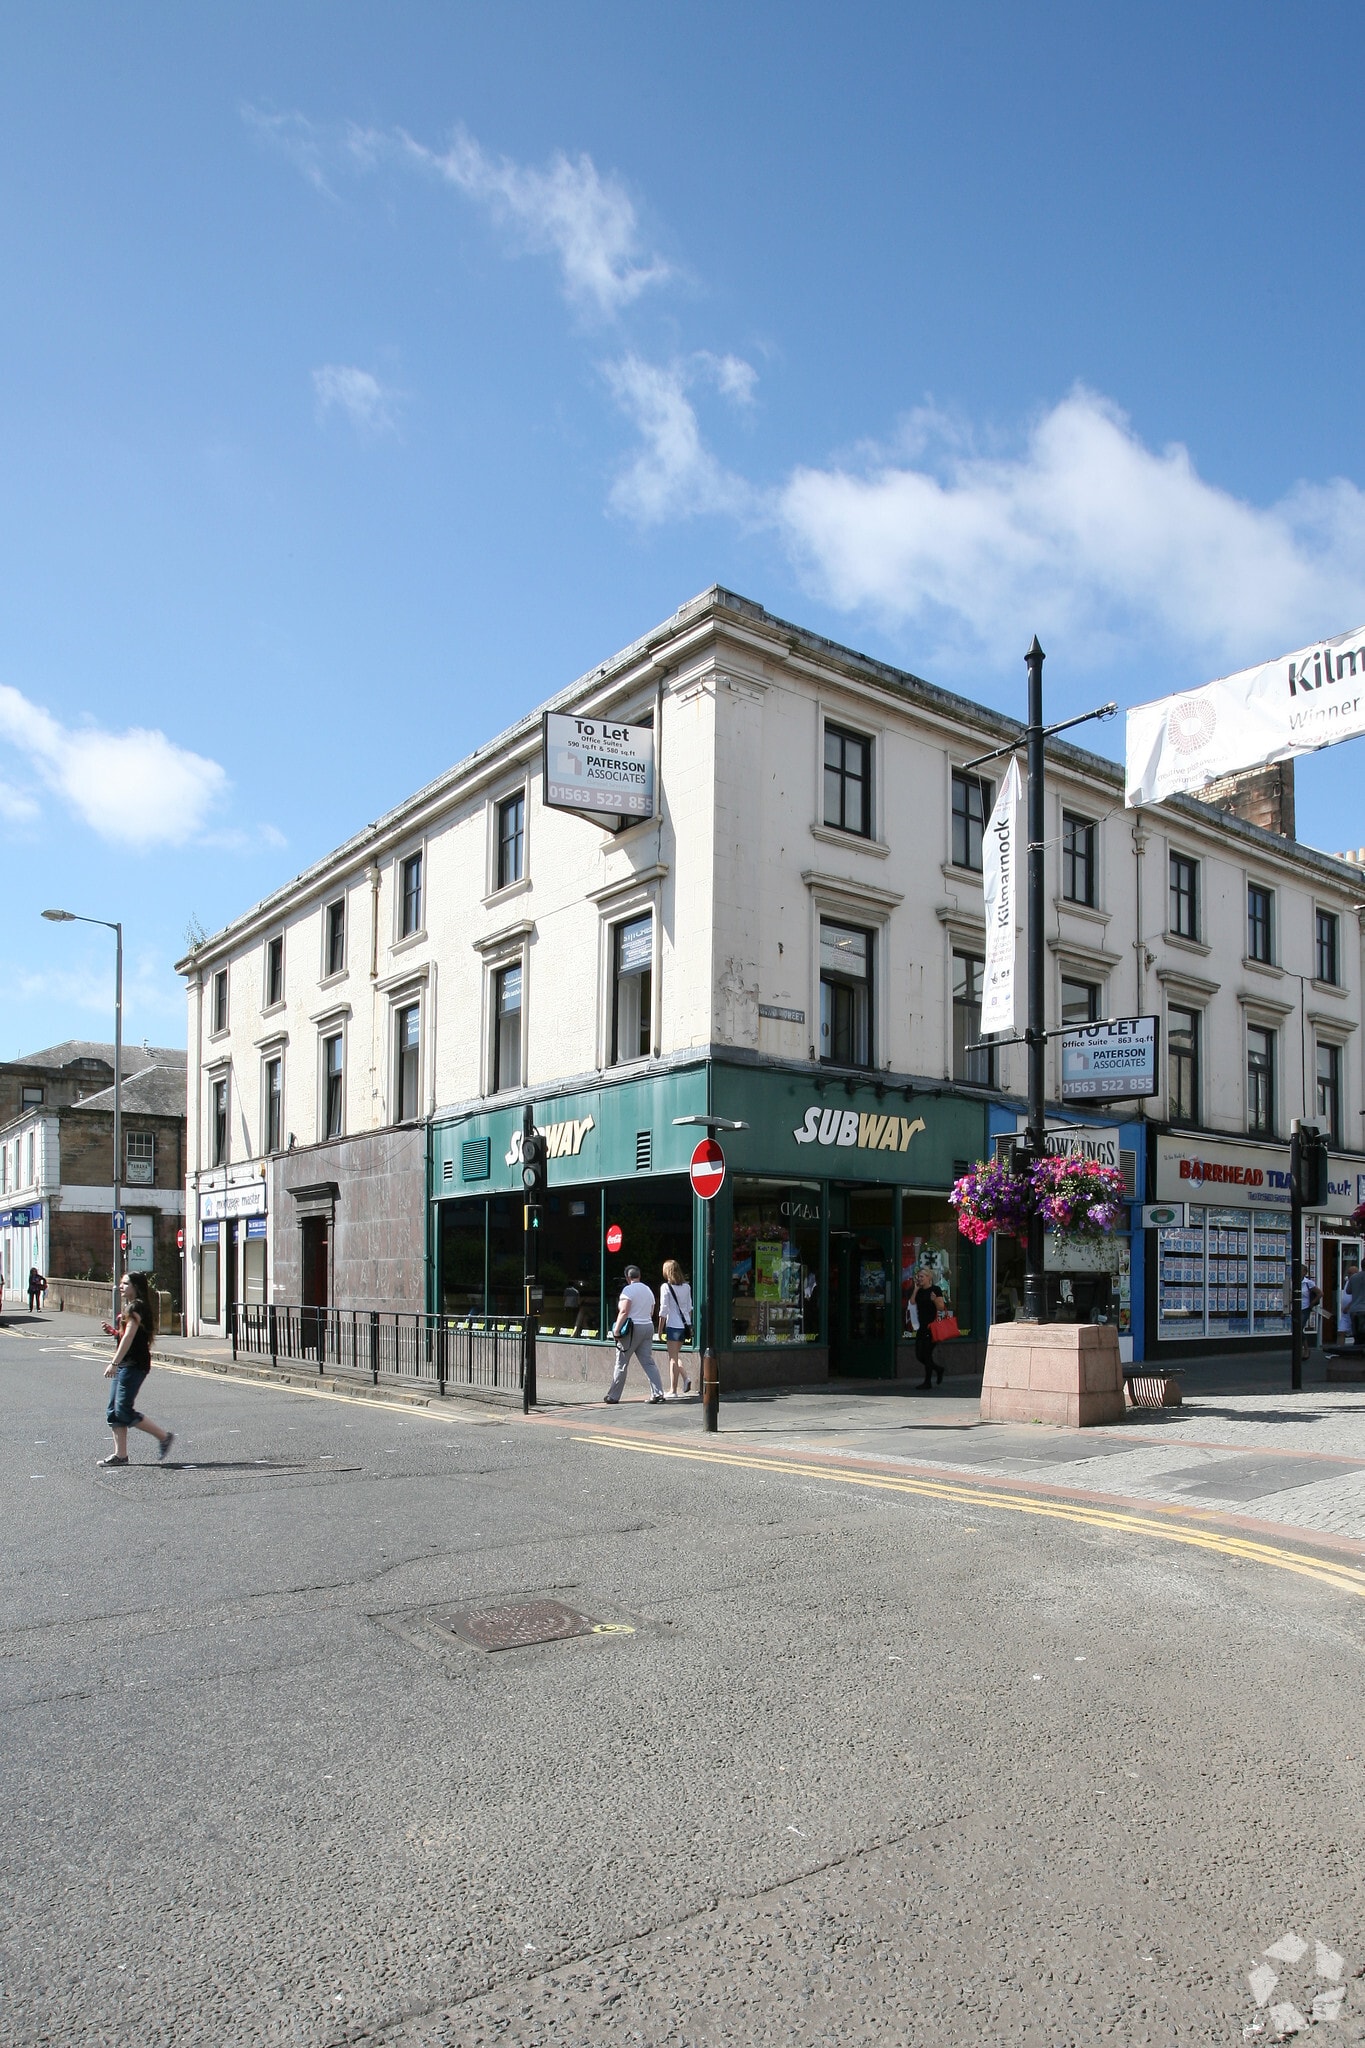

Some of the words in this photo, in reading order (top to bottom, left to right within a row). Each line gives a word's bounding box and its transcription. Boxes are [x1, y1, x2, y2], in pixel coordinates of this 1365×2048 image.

[1289, 697, 1361, 730] Winner
[574, 720, 595, 736] To
[602, 724, 630, 742] Let
[581, 736, 601, 744] Office
[603, 740, 623, 748] Suites
[586, 756, 646, 773] PATERSON
[587, 768, 646, 785] ASSOCIATES
[549, 785, 591, 803] 01563
[596, 792, 622, 807] 522
[628, 796, 653, 811] 855
[993, 817, 1010, 929] Kilmarnock
[1107, 1020, 1140, 1036] LET
[1088, 1038, 1108, 1047] Suite
[1134, 1035, 1154, 1044] sq.ft
[1093, 1048, 1146, 1060] PATERSON
[1093, 1058, 1146, 1070] ASSOCIATES
[1062, 1081, 1096, 1094] 01563
[1101, 1080, 1124, 1091] 522
[1129, 1078, 1153, 1090] 855
[793, 1106, 926, 1153] SUBWAY
[505, 1114, 595, 1167] SWAY
[1179, 1159, 1263, 1187] BARRHEAD
